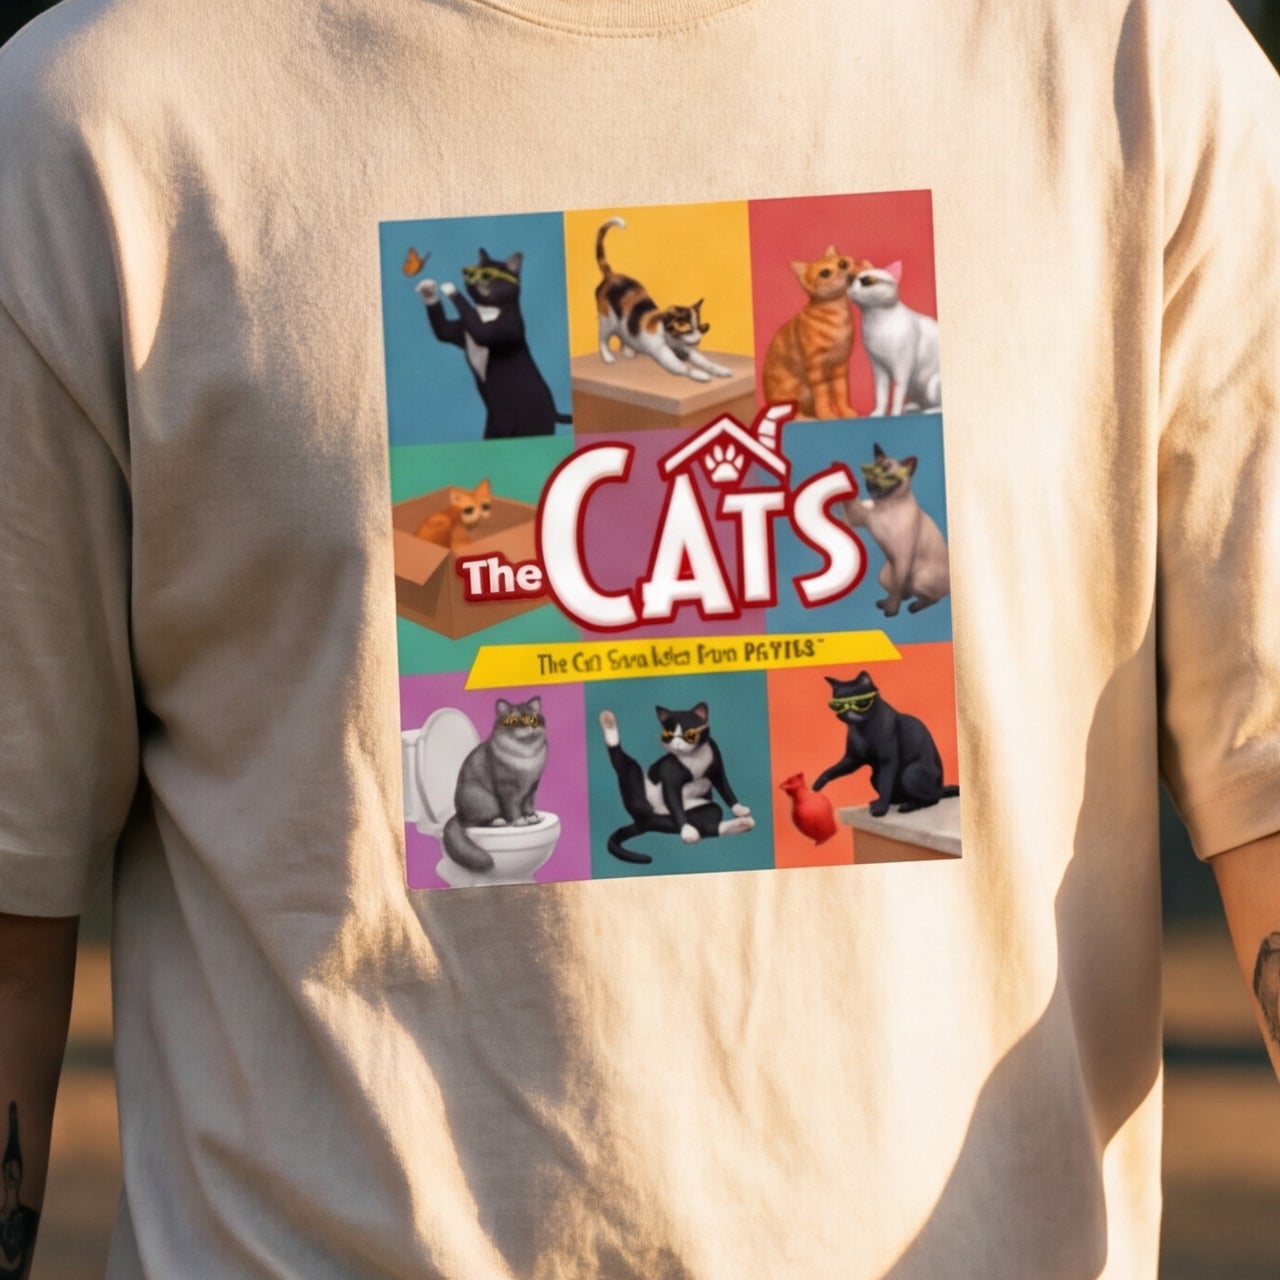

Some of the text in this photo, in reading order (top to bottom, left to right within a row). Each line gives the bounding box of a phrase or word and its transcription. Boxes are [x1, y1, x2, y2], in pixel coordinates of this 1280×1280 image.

[458, 443, 865, 629] The CATS
[537, 652, 568, 676] The
